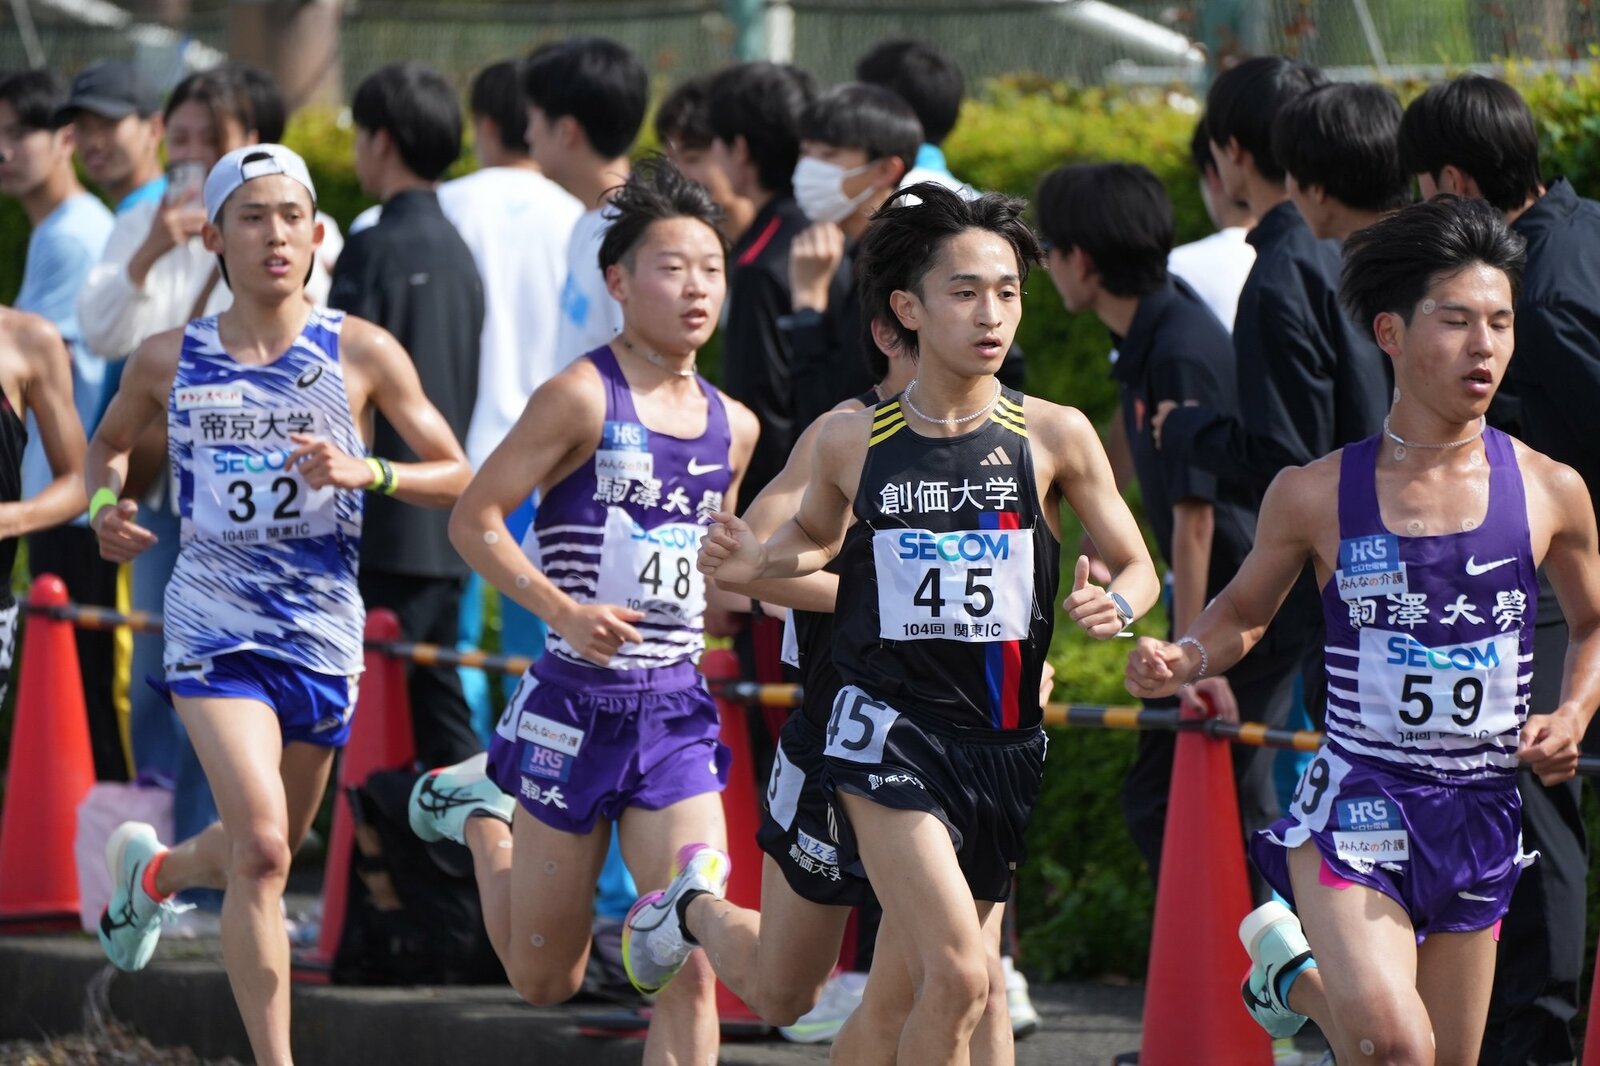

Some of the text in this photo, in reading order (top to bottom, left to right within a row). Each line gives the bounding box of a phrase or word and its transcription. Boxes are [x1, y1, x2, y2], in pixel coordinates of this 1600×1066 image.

[200, 412, 314, 440] 帝京大学
[612, 424, 641, 445] HRS
[213, 449, 298, 474] SECO
[228, 477, 300, 523] 32
[879, 476, 1019, 515] 創価大学
[222, 529, 259, 542] 104回
[899, 532, 1009, 562] SECOM
[1350, 538, 1387, 562] HRS
[638, 551, 691, 600] 48
[1340, 571, 1405, 590] みんなの介護
[913, 567, 994, 618] 45
[1345, 588, 1527, 631] 駒澤大學
[903, 622, 1001, 637] 104回 関東IC
[1386, 635, 1500, 671] SECOM
[1399, 674, 1484, 727] 59
[828, 689, 888, 751] 45
[530, 745, 565, 770] HRS
[1347, 799, 1388, 824] HRS
[1338, 839, 1406, 853] みんなの介護
[789, 844, 842, 882] 創価大学
